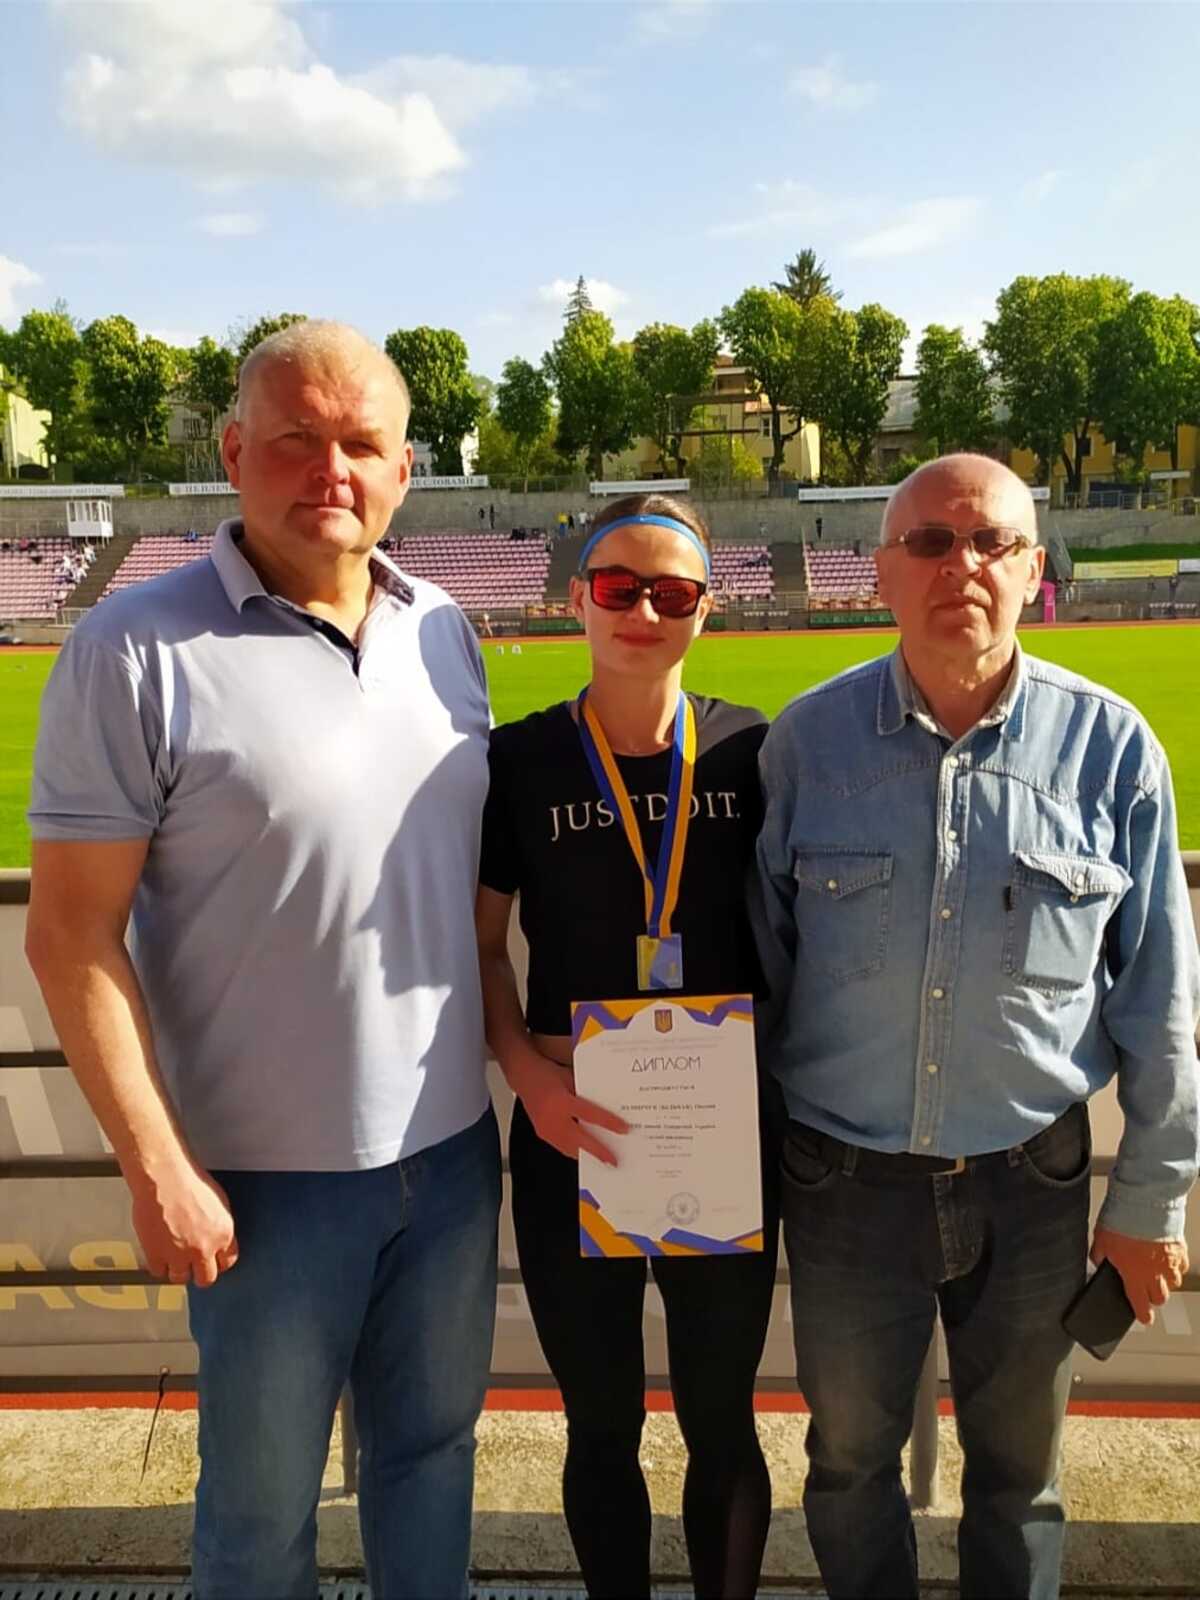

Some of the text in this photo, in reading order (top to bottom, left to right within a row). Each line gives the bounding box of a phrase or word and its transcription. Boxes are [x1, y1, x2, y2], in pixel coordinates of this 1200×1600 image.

[550, 795, 639, 842] JUS
[704, 791, 741, 819] IT.
[631, 1055, 701, 1072] ДИПЛОМ
